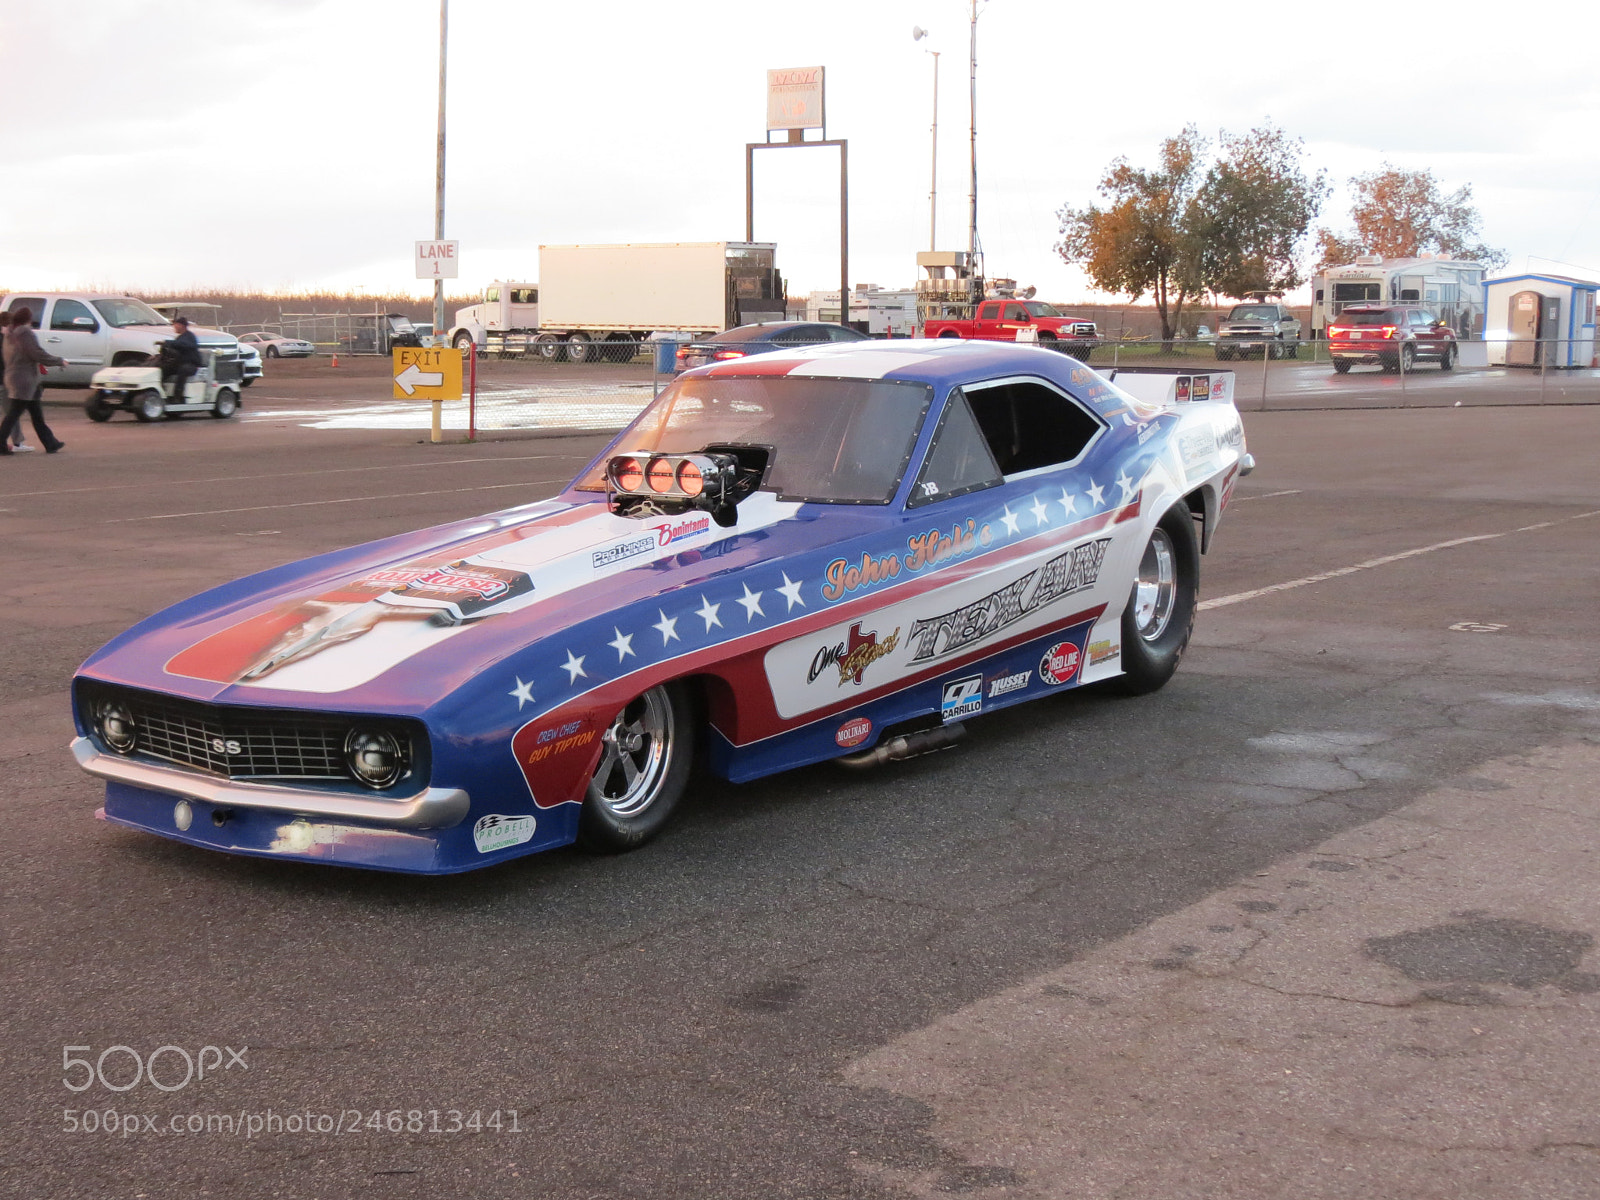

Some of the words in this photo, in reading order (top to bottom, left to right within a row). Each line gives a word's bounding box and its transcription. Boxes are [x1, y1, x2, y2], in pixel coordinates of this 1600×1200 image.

[419, 244, 454, 259] LANE
[432, 260, 441, 275] 1
[401, 351, 441, 366] EXIT
[822, 552, 900, 602] John
[905, 517, 993, 571] Hale's
[905, 538, 1112, 664] TEXAN
[807, 641, 845, 684] One
[1051, 656, 1064, 671] RED
[1064, 652, 1078, 667] LINE
[943, 679, 981, 706] CP
[988, 670, 1033, 698] HUSSEY
[942, 701, 981, 720] CARRILLO
[536, 728, 559, 745] CREW
[559, 720, 582, 738] CHIEF
[837, 723, 869, 742] MOLINARI
[212, 738, 242, 755] SS
[528, 744, 553, 764] GUY
[554, 730, 597, 755] TIPTON
[477, 820, 530, 841] PROBELL
